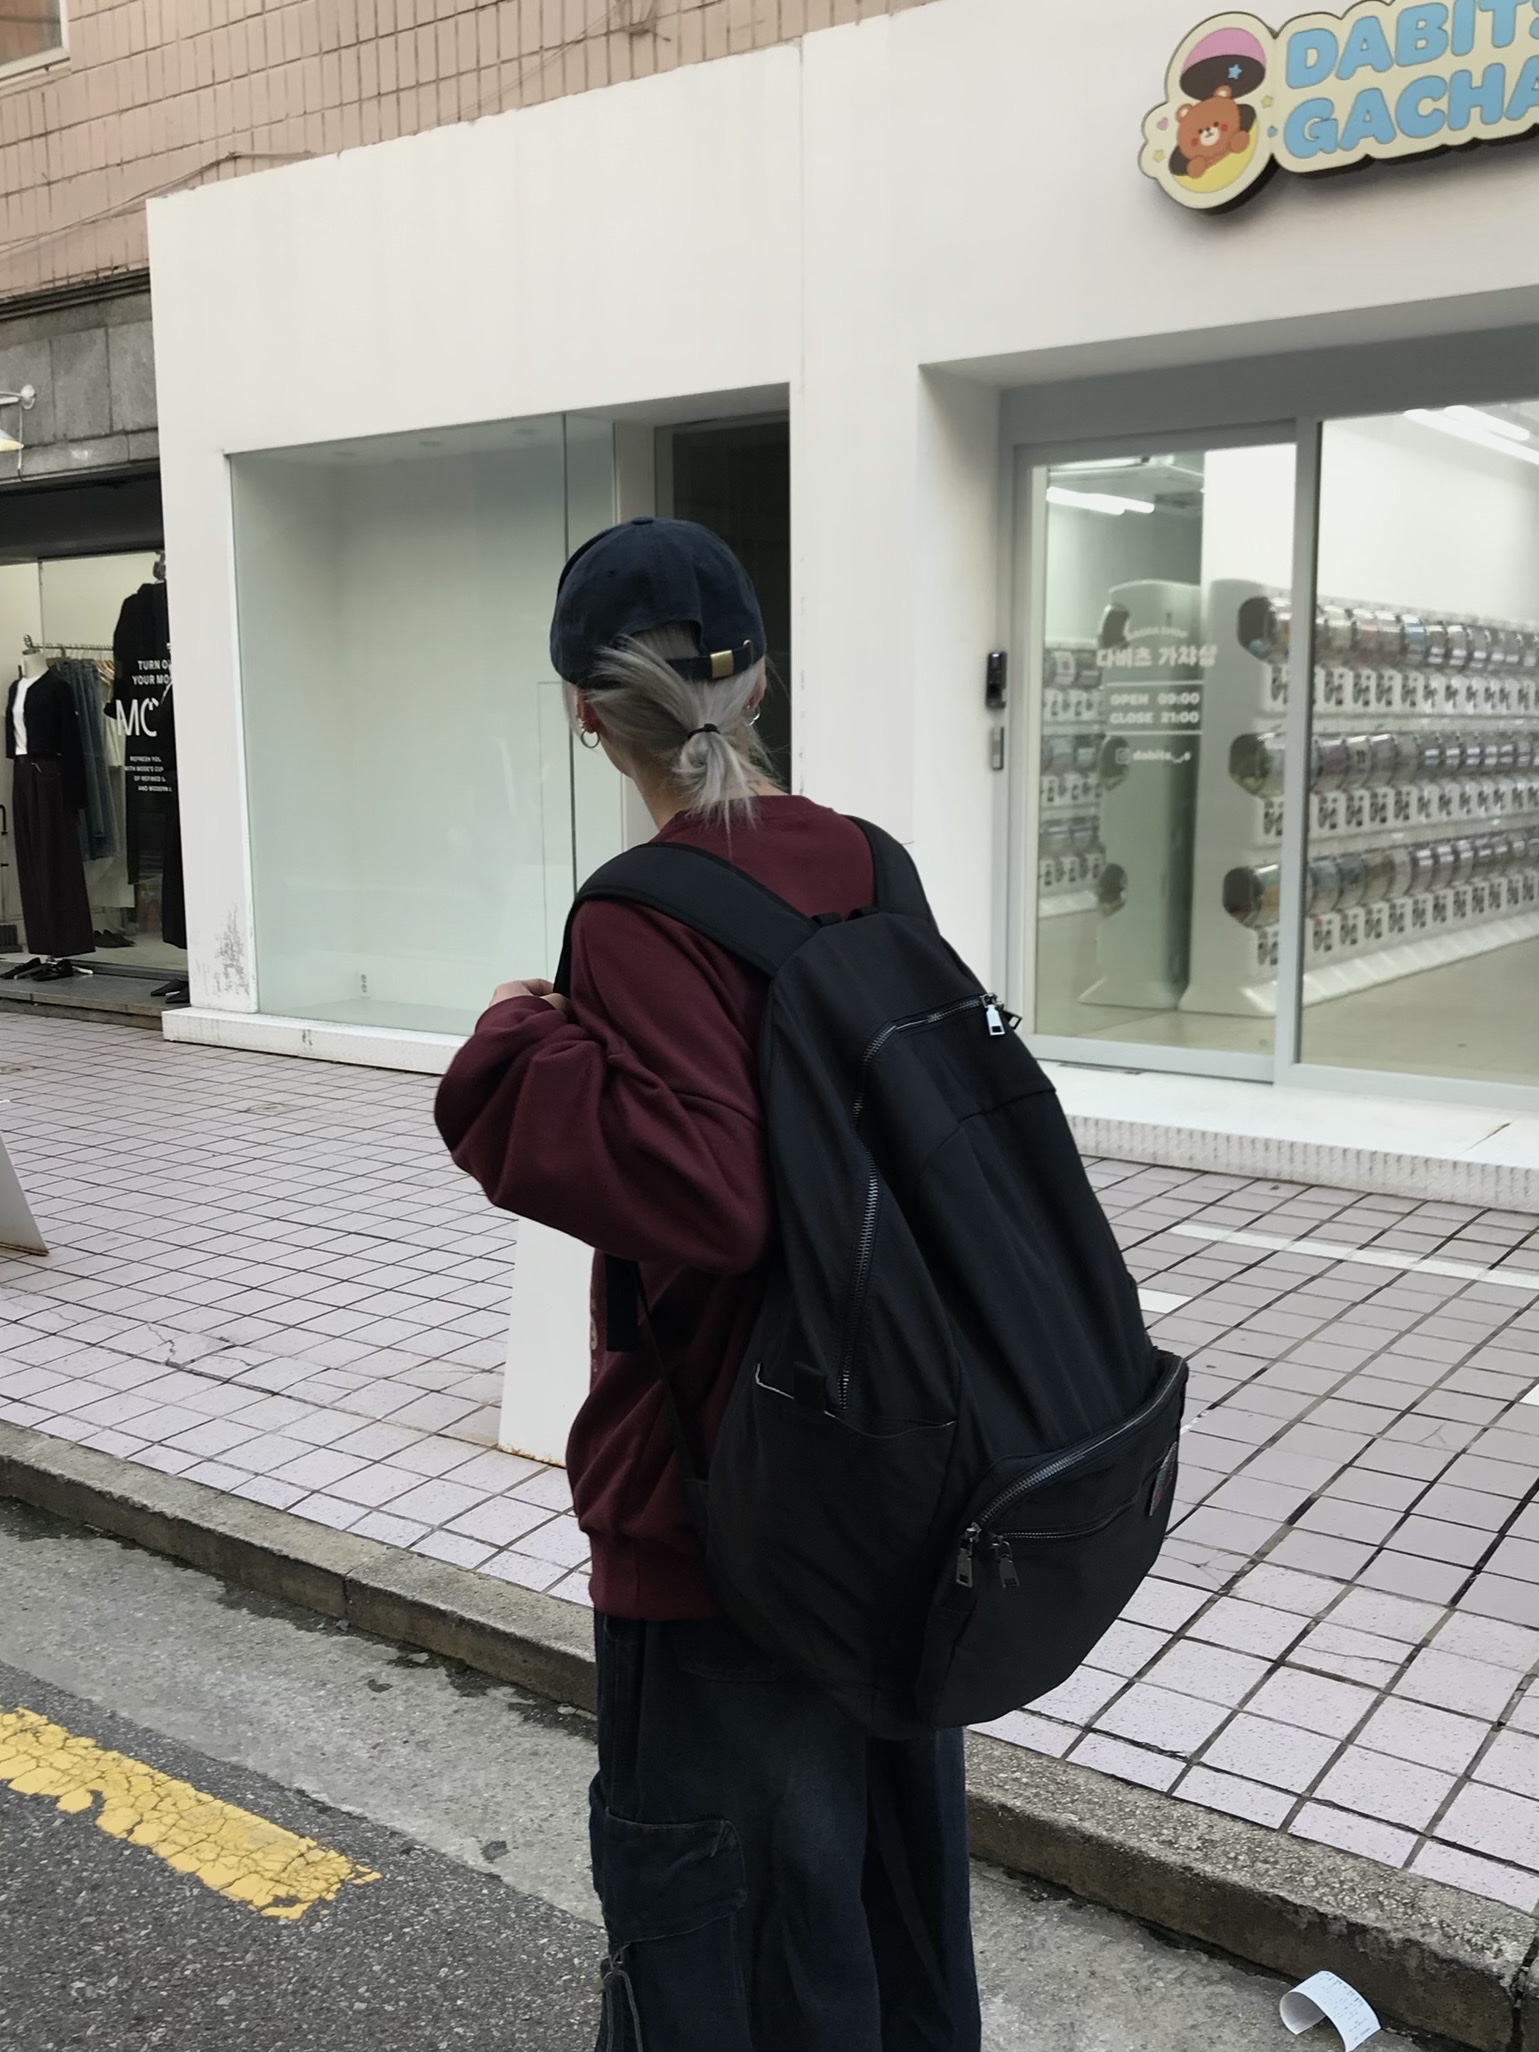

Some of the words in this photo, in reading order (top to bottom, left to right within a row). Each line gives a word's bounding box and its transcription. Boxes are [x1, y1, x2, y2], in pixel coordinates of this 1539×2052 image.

[1286, 0, 1539, 90] DABIT
[1284, 54, 1539, 160] GACHA
[1096, 647, 1153, 668] 다비츠
[138, 660, 160, 670] TURN
[132, 675, 155, 685] YOUR
[156, 674, 171, 685] MO
[1110, 694, 1150, 706] OPEN
[1110, 711, 1154, 724] CLOSE
[1160, 711, 1200, 724] 21:00
